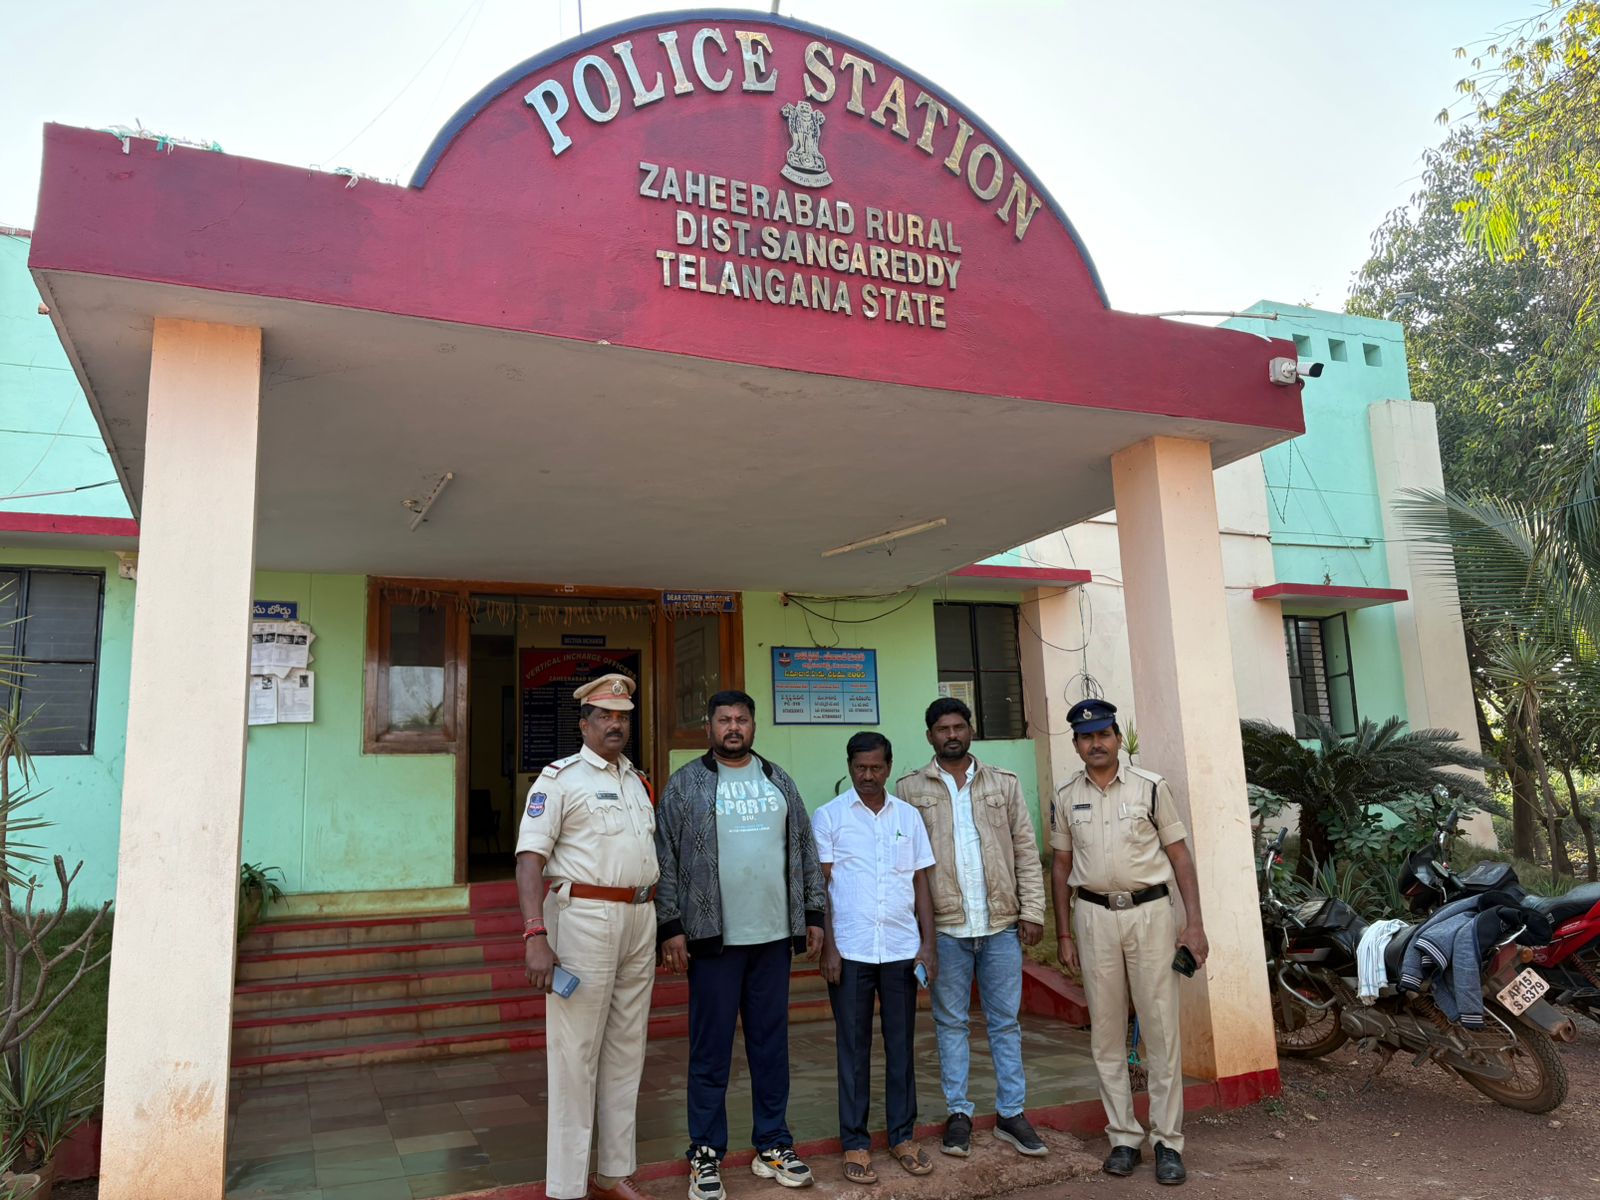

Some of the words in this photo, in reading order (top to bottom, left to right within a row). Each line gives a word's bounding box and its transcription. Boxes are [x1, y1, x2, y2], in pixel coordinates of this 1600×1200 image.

[524, 28, 778, 156] POLICE
[803, 41, 1042, 240] STATION
[639, 161, 855, 236] ZAHEERABAD
[865, 206, 962, 253] RURAL
[676, 209, 962, 290] DIST.SANGAREDDY
[656, 249, 852, 316] TELANGANA
[861, 288, 948, 329] STATE
[526, 656, 561, 680] VERTICAL
[563, 652, 602, 662] INCHARGE
[716, 796, 779, 815] SPORTS
[717, 779, 775, 799] MOVE
[1513, 1000, 1524, 1011] S
[1521, 981, 1546, 1004] 6379
